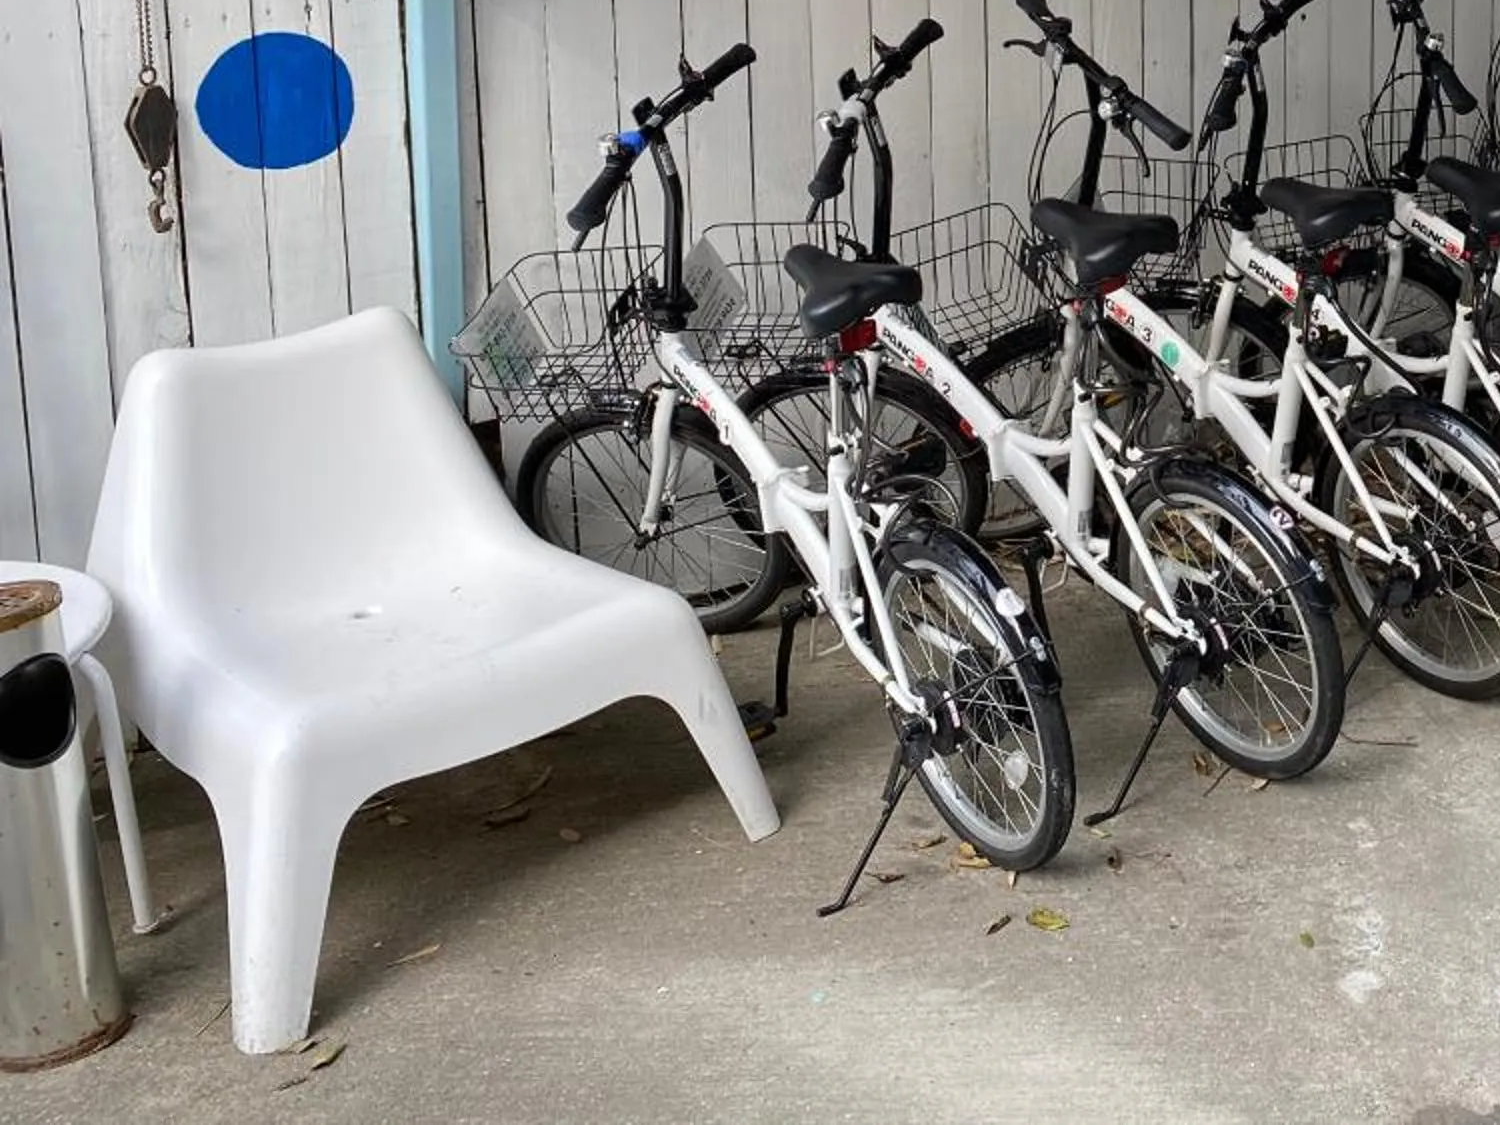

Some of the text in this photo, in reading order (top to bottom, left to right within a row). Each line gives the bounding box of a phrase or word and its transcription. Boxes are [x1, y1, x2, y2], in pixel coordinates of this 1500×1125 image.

[1142, 327, 1153, 342] 3
[941, 382, 951, 395] 2
[1273, 508, 1290, 526] 2
